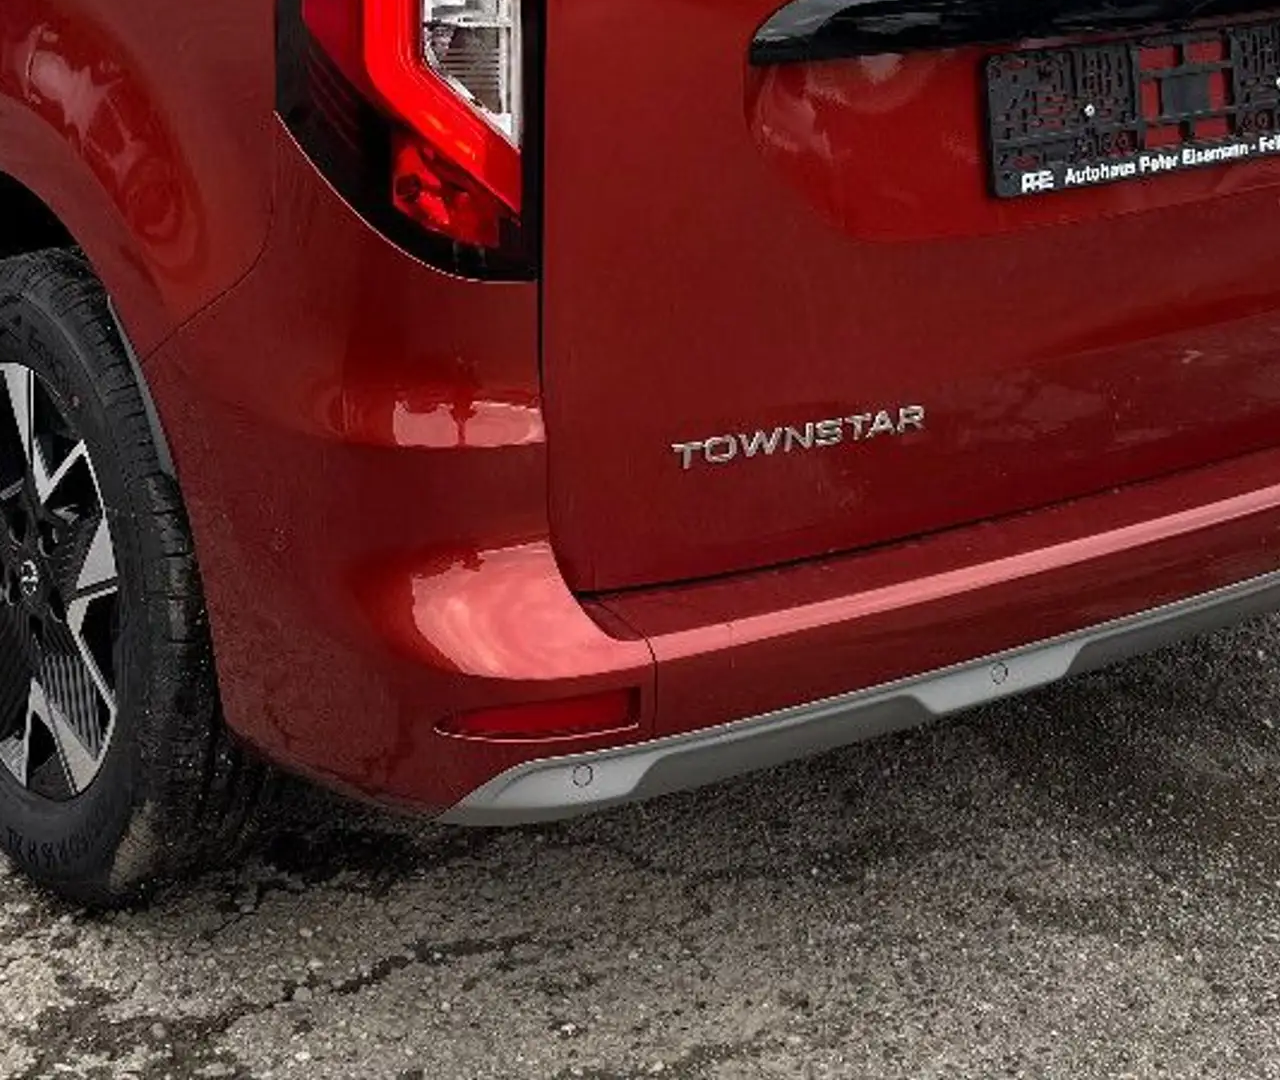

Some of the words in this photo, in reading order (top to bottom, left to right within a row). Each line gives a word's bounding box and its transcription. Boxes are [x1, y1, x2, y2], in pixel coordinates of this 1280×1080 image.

[1065, 162, 1136, 186] Autohaus
[1139, 153, 1179, 173] Peter
[671, 404, 926, 470] TOWNSTAR
